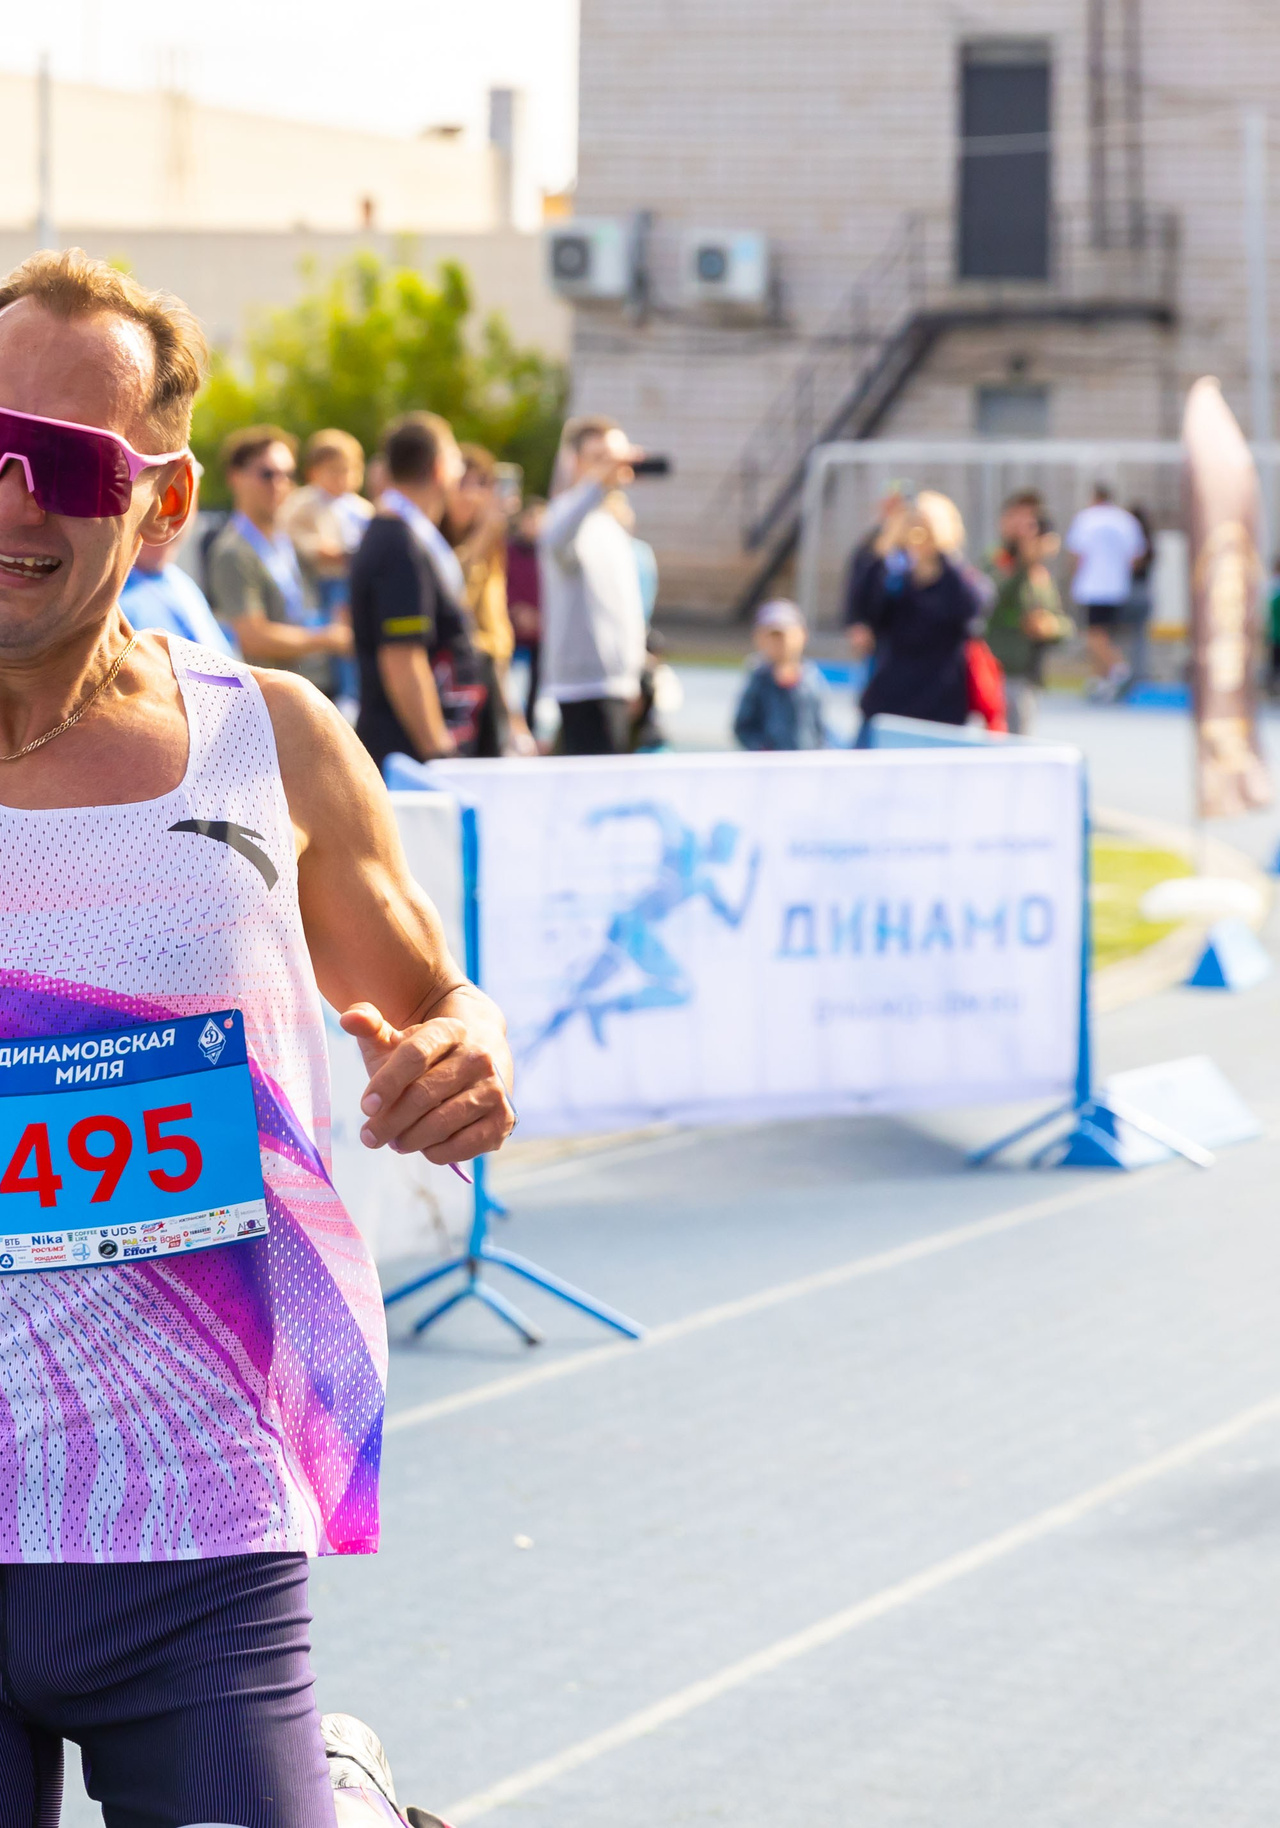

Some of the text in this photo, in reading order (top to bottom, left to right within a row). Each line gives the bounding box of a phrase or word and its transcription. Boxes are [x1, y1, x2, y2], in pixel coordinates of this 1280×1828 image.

[776, 893, 1056, 960] ДИНАМО
[55, 1060, 124, 1085] МИЛЯ
[0, 1102, 203, 1208] 495
[111, 1226, 137, 1236] UDS
[4, 1238, 20, 1246] ВТБ
[31, 1234, 63, 1246] Nika
[123, 1245, 158, 1257] Effort
